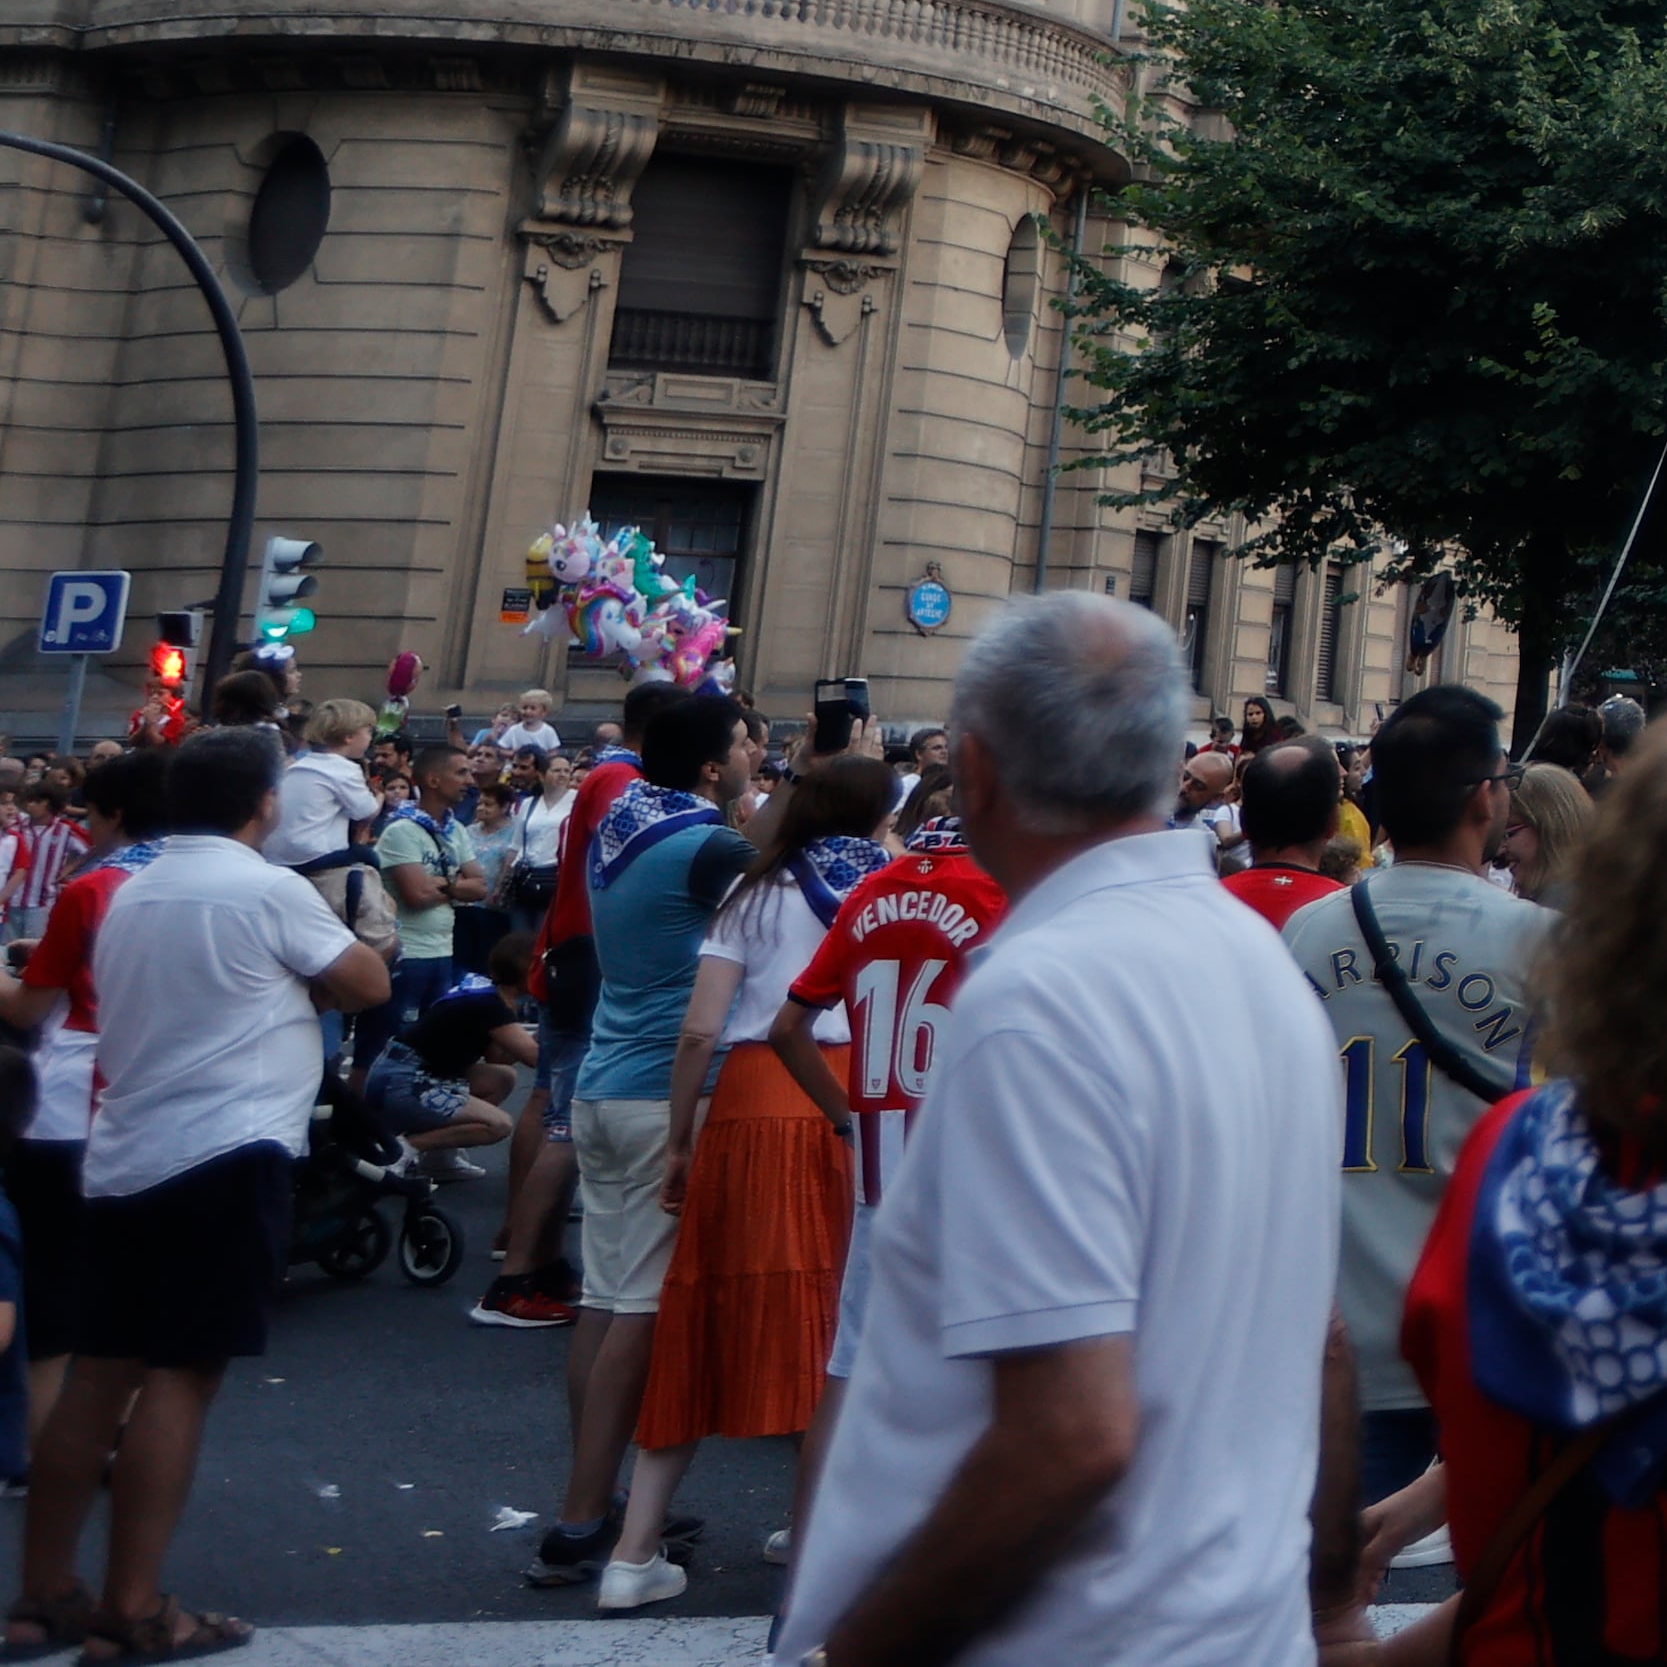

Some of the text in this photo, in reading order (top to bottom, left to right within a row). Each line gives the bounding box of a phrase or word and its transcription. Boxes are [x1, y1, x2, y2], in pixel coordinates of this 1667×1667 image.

[56, 582, 107, 644] P
[852, 890, 980, 948] VENCEDOR
[853, 958, 954, 1099] 16
[1338, 1035, 1436, 1175] 11
